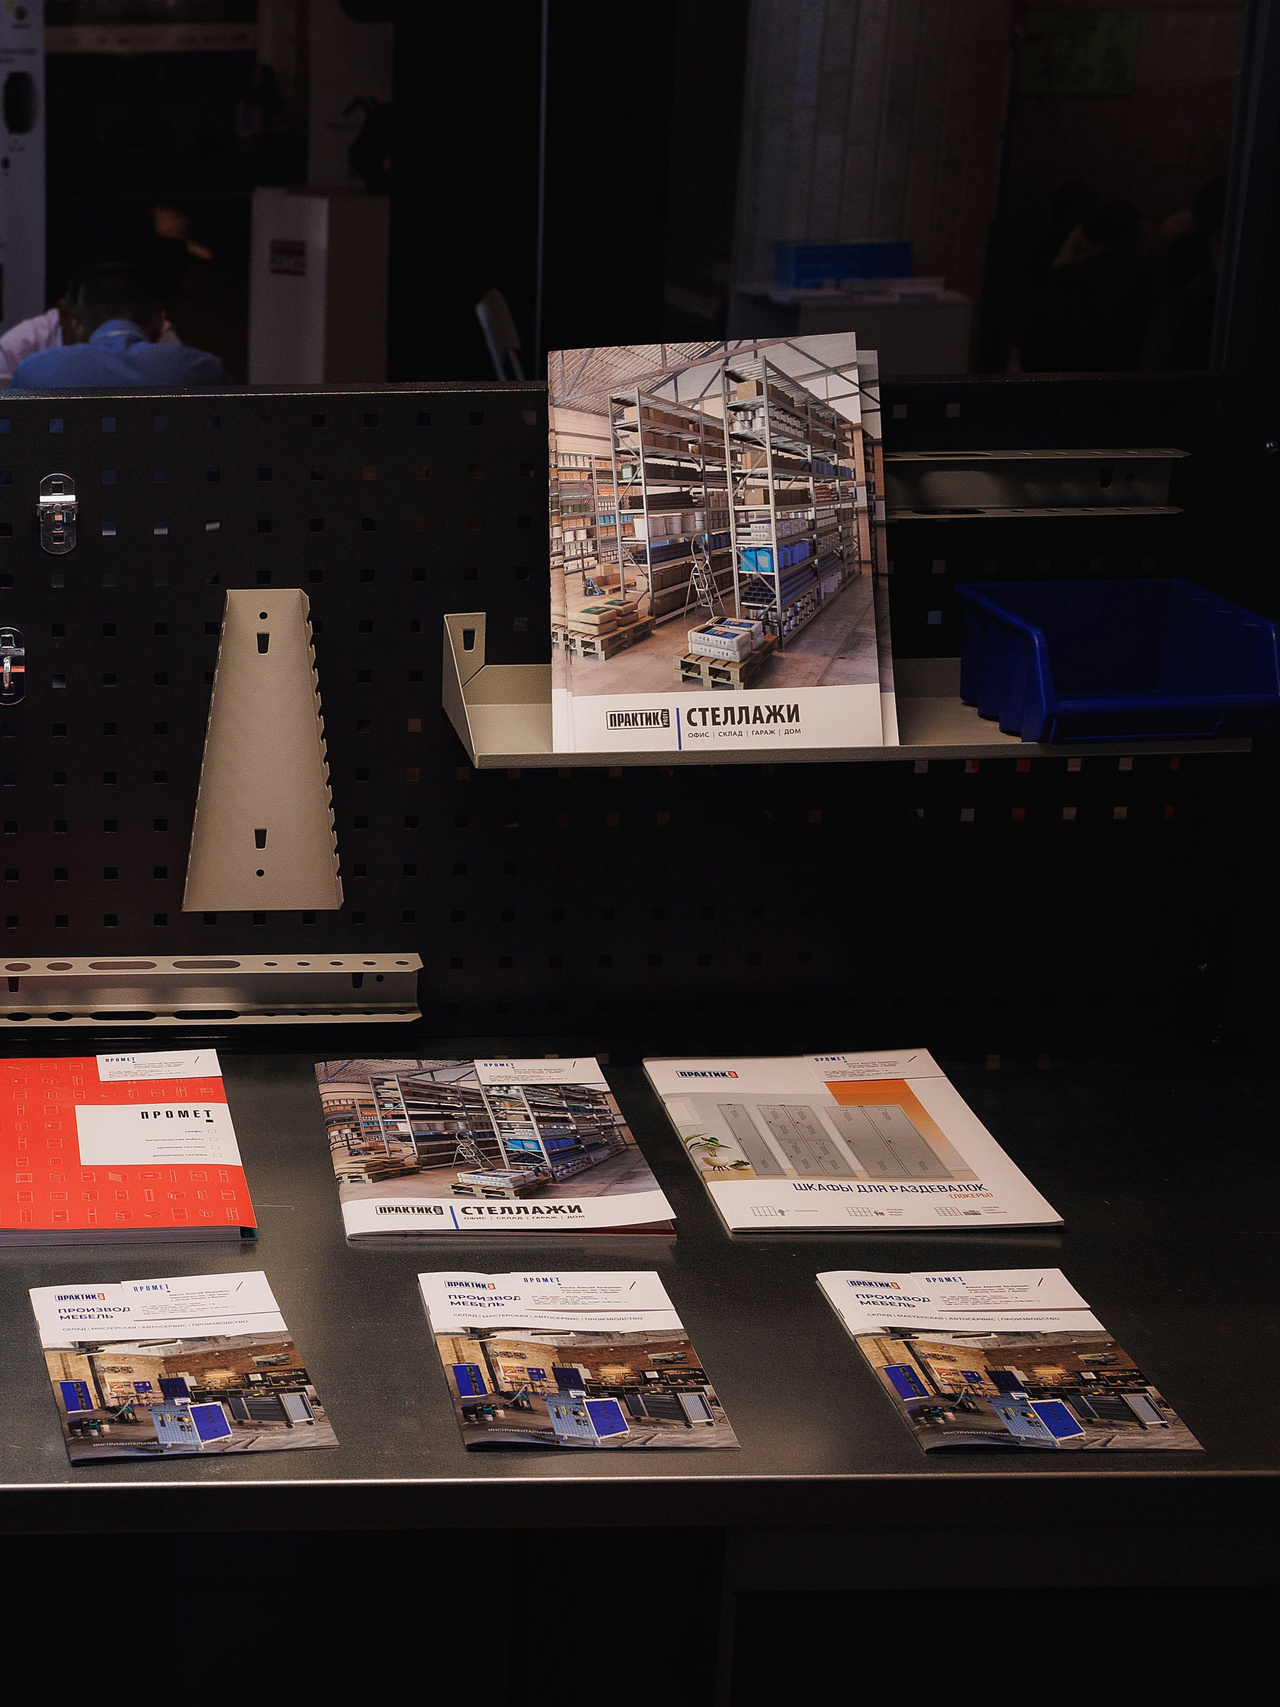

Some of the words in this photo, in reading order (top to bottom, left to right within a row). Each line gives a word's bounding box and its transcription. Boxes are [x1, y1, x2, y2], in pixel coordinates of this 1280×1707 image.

[609, 711, 661, 727] ПРАКТИК
[686, 703, 800, 727] СТЕЛЛАЖИ
[688, 731, 710, 739] ОФИС
[718, 730, 744, 738] СКЛАД
[783, 728, 802, 736] ДОМ
[140, 1109, 214, 1123] ПРОМЕТ
[792, 1183, 854, 1192] ШКАФЫ
[856, 1184, 891, 1194] ДЛЯ
[891, 1183, 988, 1194] РАЗДЕВАЛОК
[379, 1206, 433, 1214] ПРАКТИК
[460, 1204, 583, 1215] СТЕЛЛАЖИ
[523, 1277, 562, 1286] ПРОМЕТ
[849, 1280, 892, 1289] ПРАКТИК
[925, 1276, 967, 1285] ПРОМЕТ
[133, 1284, 171, 1293] ПРОМЕТ
[447, 1281, 488, 1290] ПРАКТИК
[448, 1294, 521, 1302] ПРОИЗВОД
[855, 1293, 931, 1303] ПРОИЗВОД
[191, 1319, 249, 1327] ПРОИЗВОДСТВО
